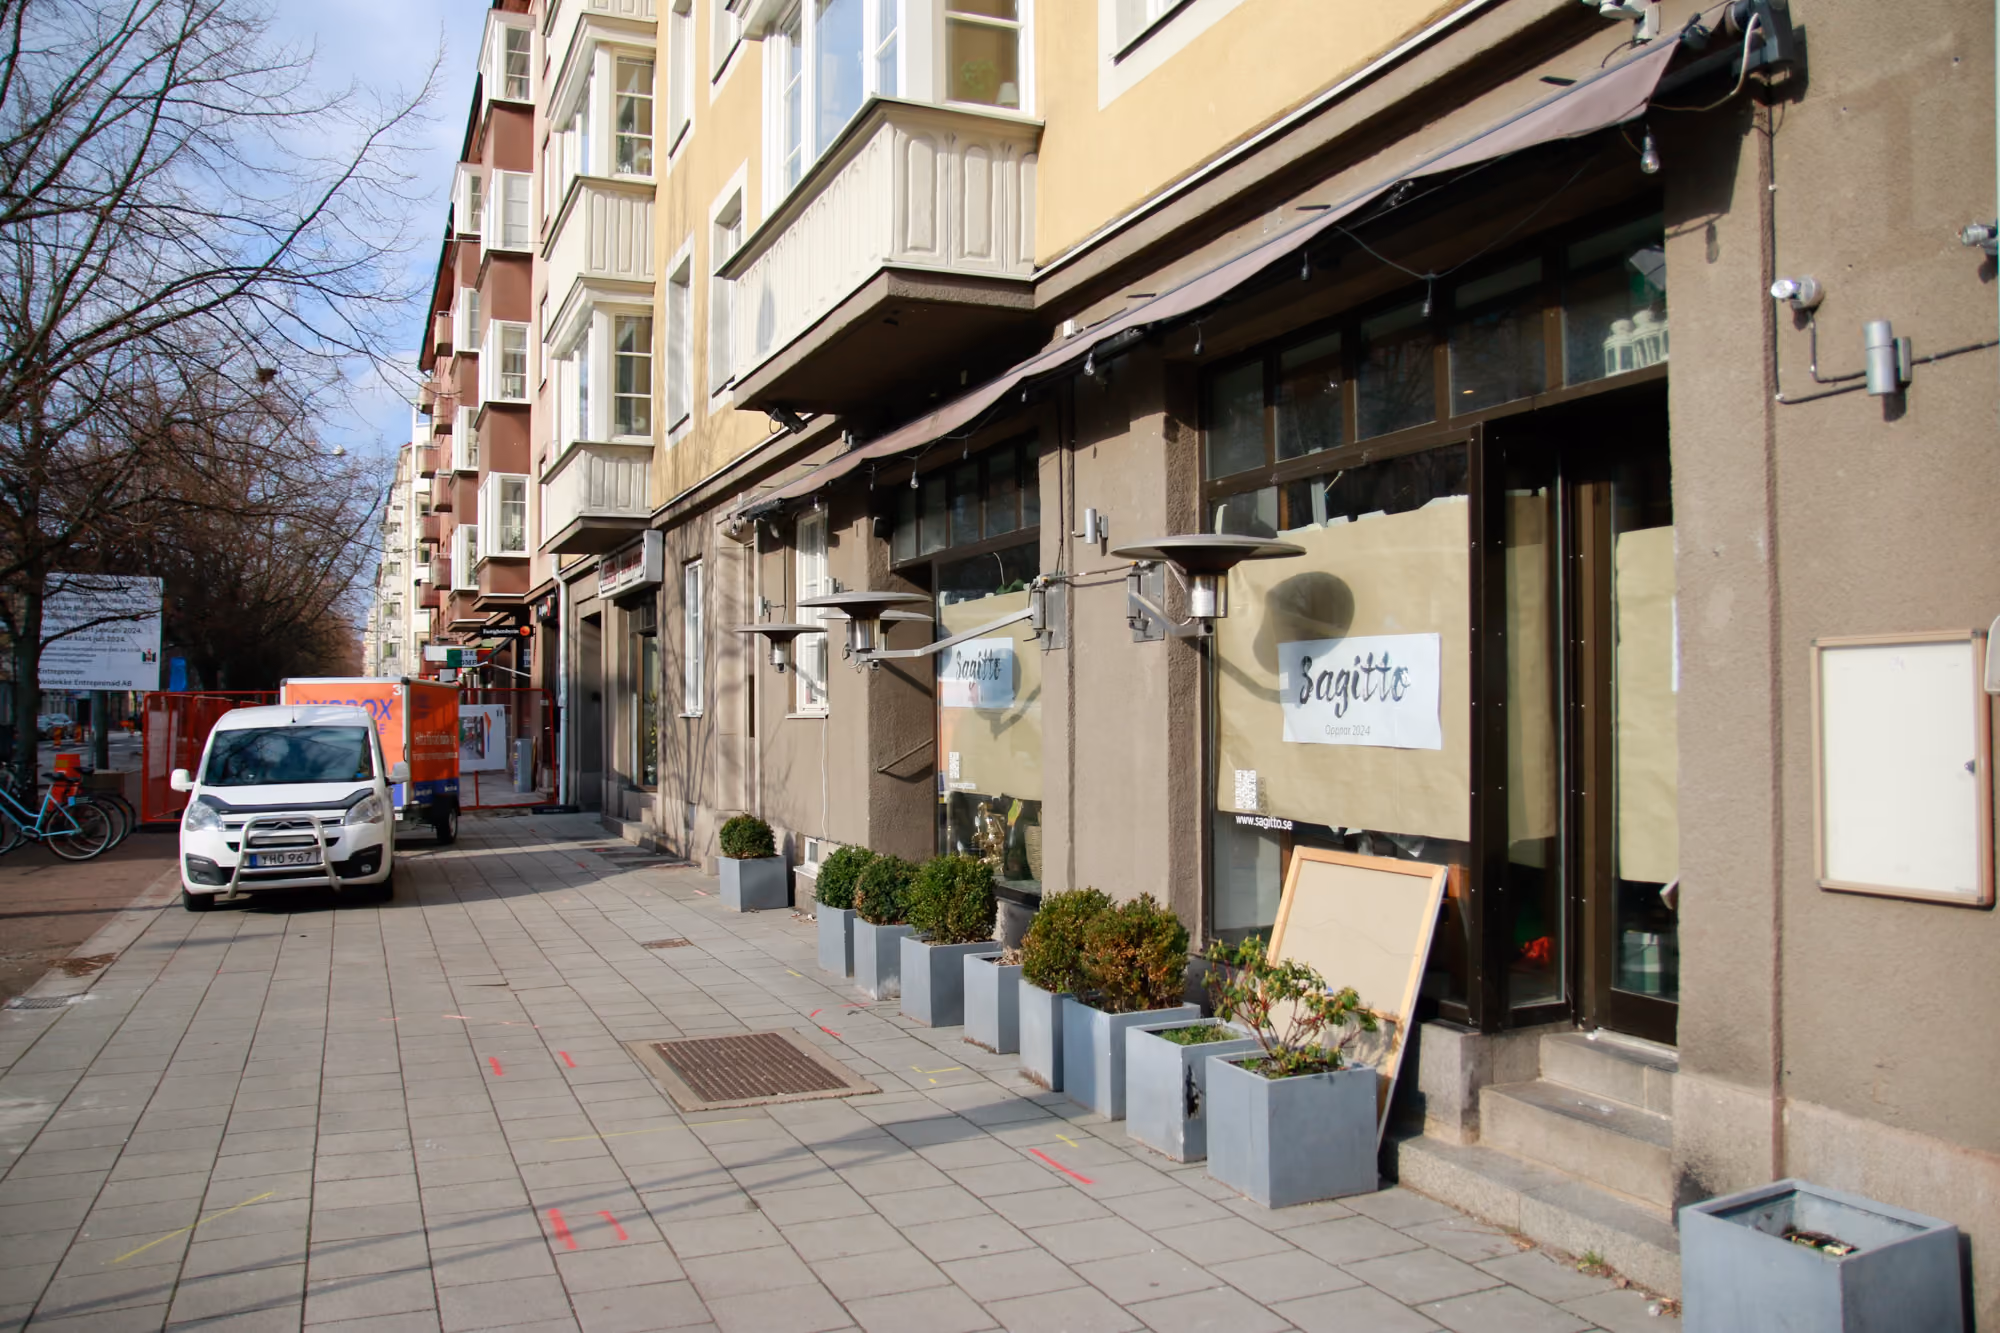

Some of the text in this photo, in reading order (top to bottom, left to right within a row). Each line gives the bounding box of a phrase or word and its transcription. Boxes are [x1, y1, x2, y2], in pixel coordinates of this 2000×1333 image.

[1300, 651, 1411, 718] Sagitto
[1352, 724, 1371, 736] 2024
[1235, 815, 1293, 831] www.sagitto.se
[288, 852, 312, 863] 967
